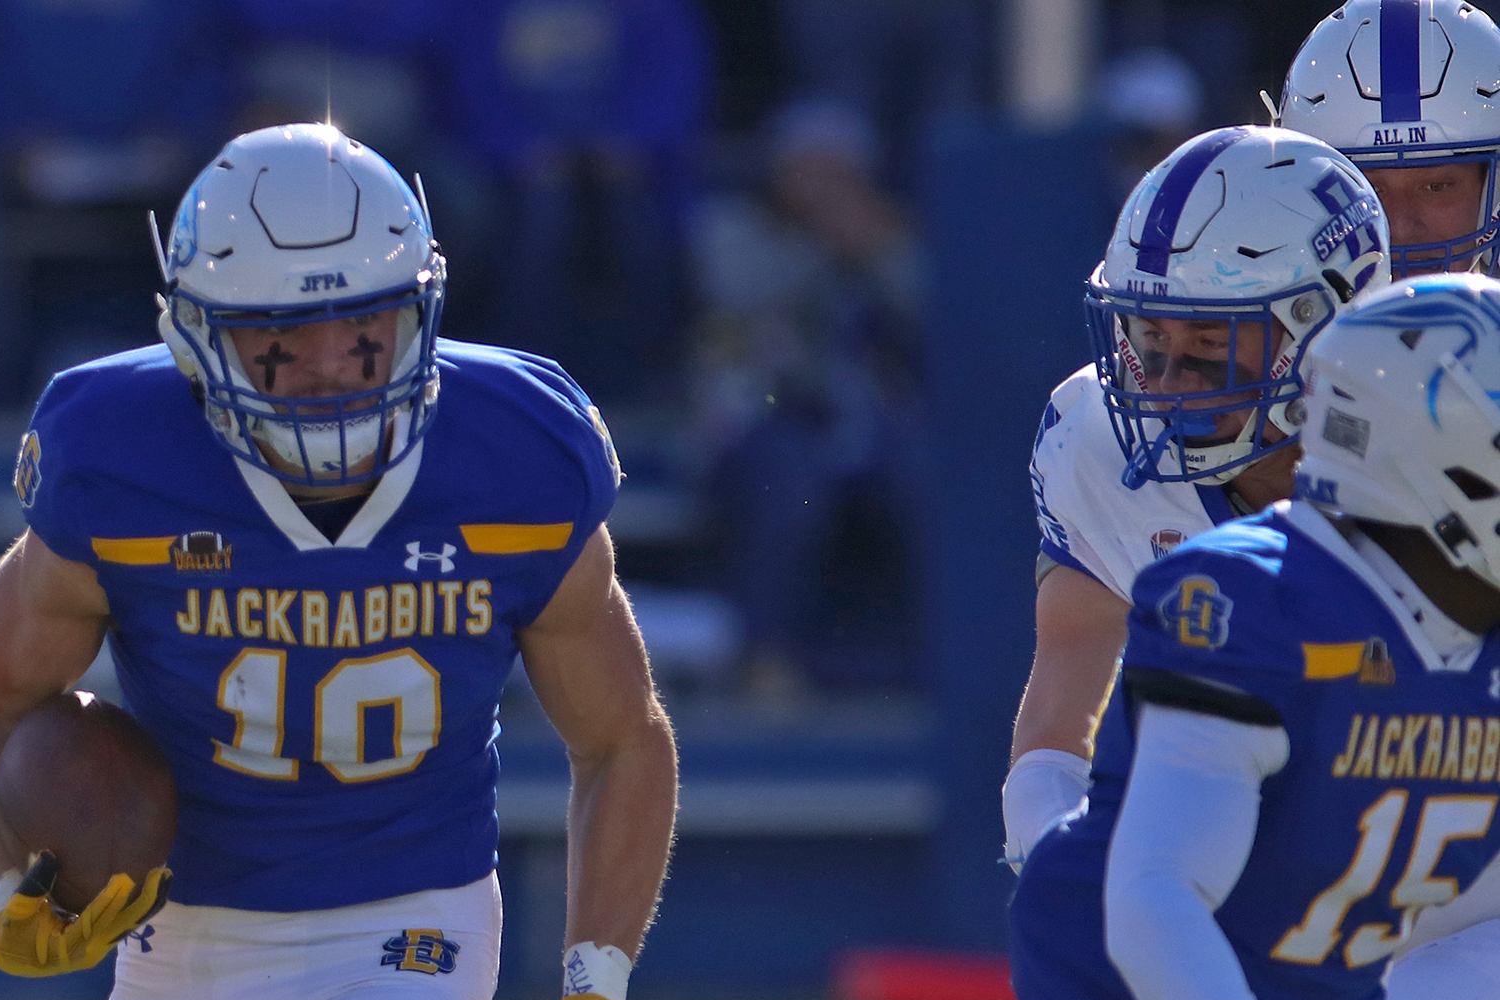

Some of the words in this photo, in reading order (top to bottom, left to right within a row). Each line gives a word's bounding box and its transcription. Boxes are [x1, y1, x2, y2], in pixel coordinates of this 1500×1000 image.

[1374, 129, 1403, 145] ALL
[1409, 126, 1426, 143] IN
[301, 272, 348, 292] JFPA
[1153, 282, 1168, 297] IN
[1270, 354, 1292, 379] dell
[176, 579, 493, 648] JACKRABBITS
[210, 647, 442, 784] 10
[1332, 714, 1500, 782] JACKRABB
[1270, 788, 1499, 970] 15
